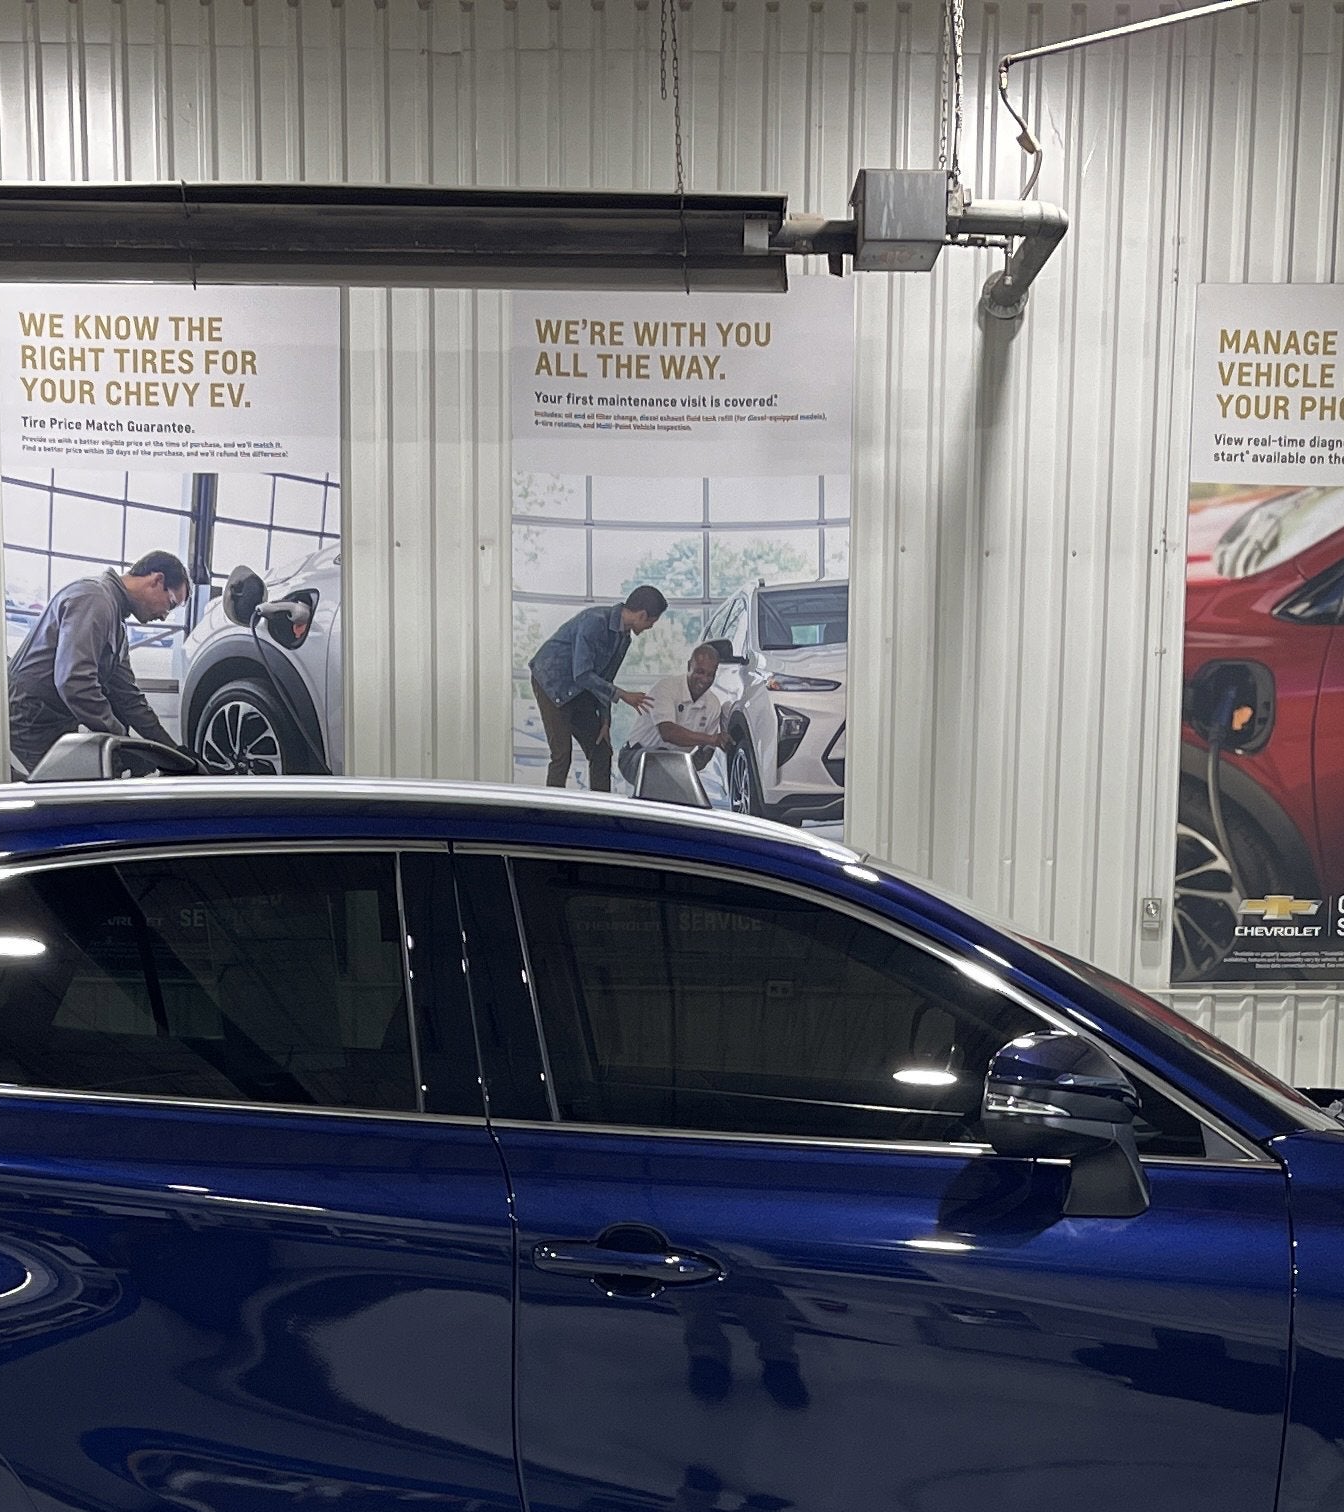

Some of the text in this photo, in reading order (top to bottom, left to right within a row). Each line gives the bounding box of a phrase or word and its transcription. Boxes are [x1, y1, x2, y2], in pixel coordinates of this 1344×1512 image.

[19, 312, 223, 342] WE KNOW THE
[535, 318, 772, 348] WE'RE WITH YOU
[1219, 328, 1338, 356] MANAGE
[21, 344, 257, 375] RIGHT TIRES FOR
[535, 351, 727, 380] ALL THE WAY.
[1218, 361, 1335, 388] VEHICLE
[20, 376, 251, 408] YOUR CHEVY EV.
[535, 391, 563, 404] Your
[566, 392, 594, 406] first
[597, 394, 677, 407] maintenance
[680, 395, 707, 407] visit
[710, 395, 721, 407] is
[1216, 394, 1290, 420] YOUR
[21, 416, 195, 434] Tire Price Match Guarantee.
[1214, 433, 1244, 445] View
[1247, 435, 1305, 447] real-time
[1251, 452, 1306, 464] available
[1309, 455, 1325, 464] on
[1234, 926, 1322, 937] CHEVROLET
